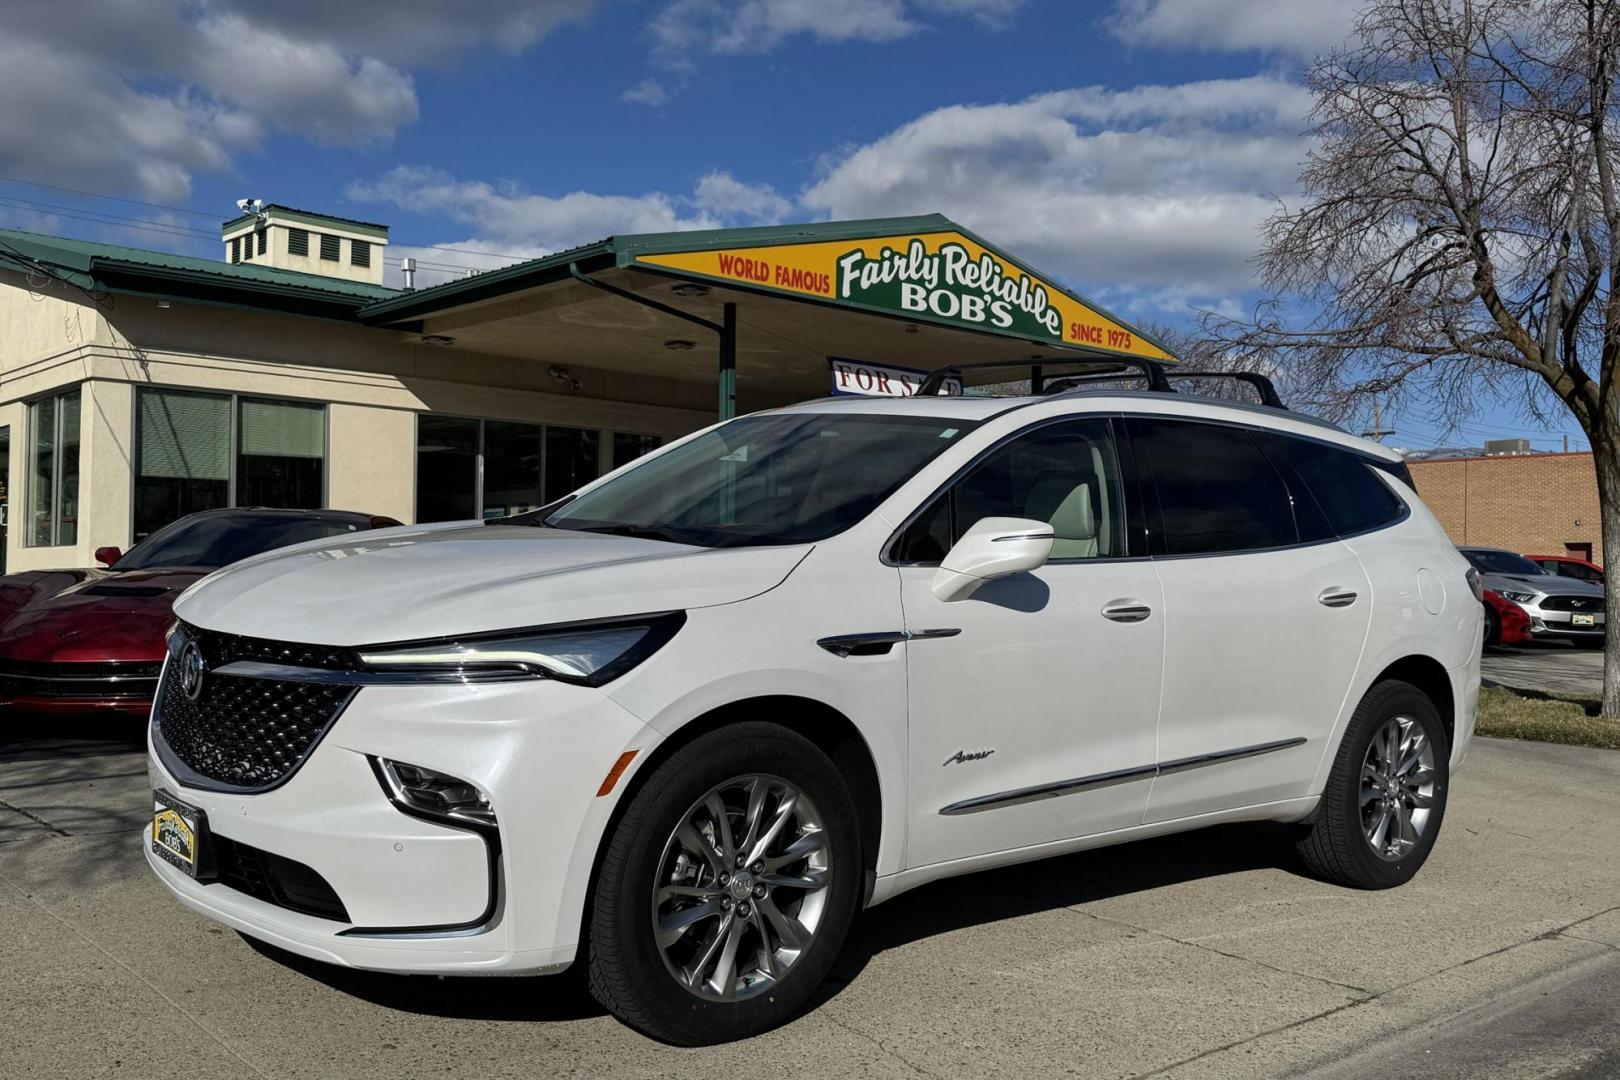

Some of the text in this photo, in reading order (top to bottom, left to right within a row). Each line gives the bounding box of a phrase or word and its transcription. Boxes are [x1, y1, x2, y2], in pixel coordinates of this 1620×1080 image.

[718, 253, 830, 294] WORLD FAMOUS
[840, 241, 1061, 336] Fairly Reliable
[901, 282, 1014, 328] BOB'S
[1070, 322, 1132, 350] SINCE 1975
[838, 365, 958, 397] FOR SE
